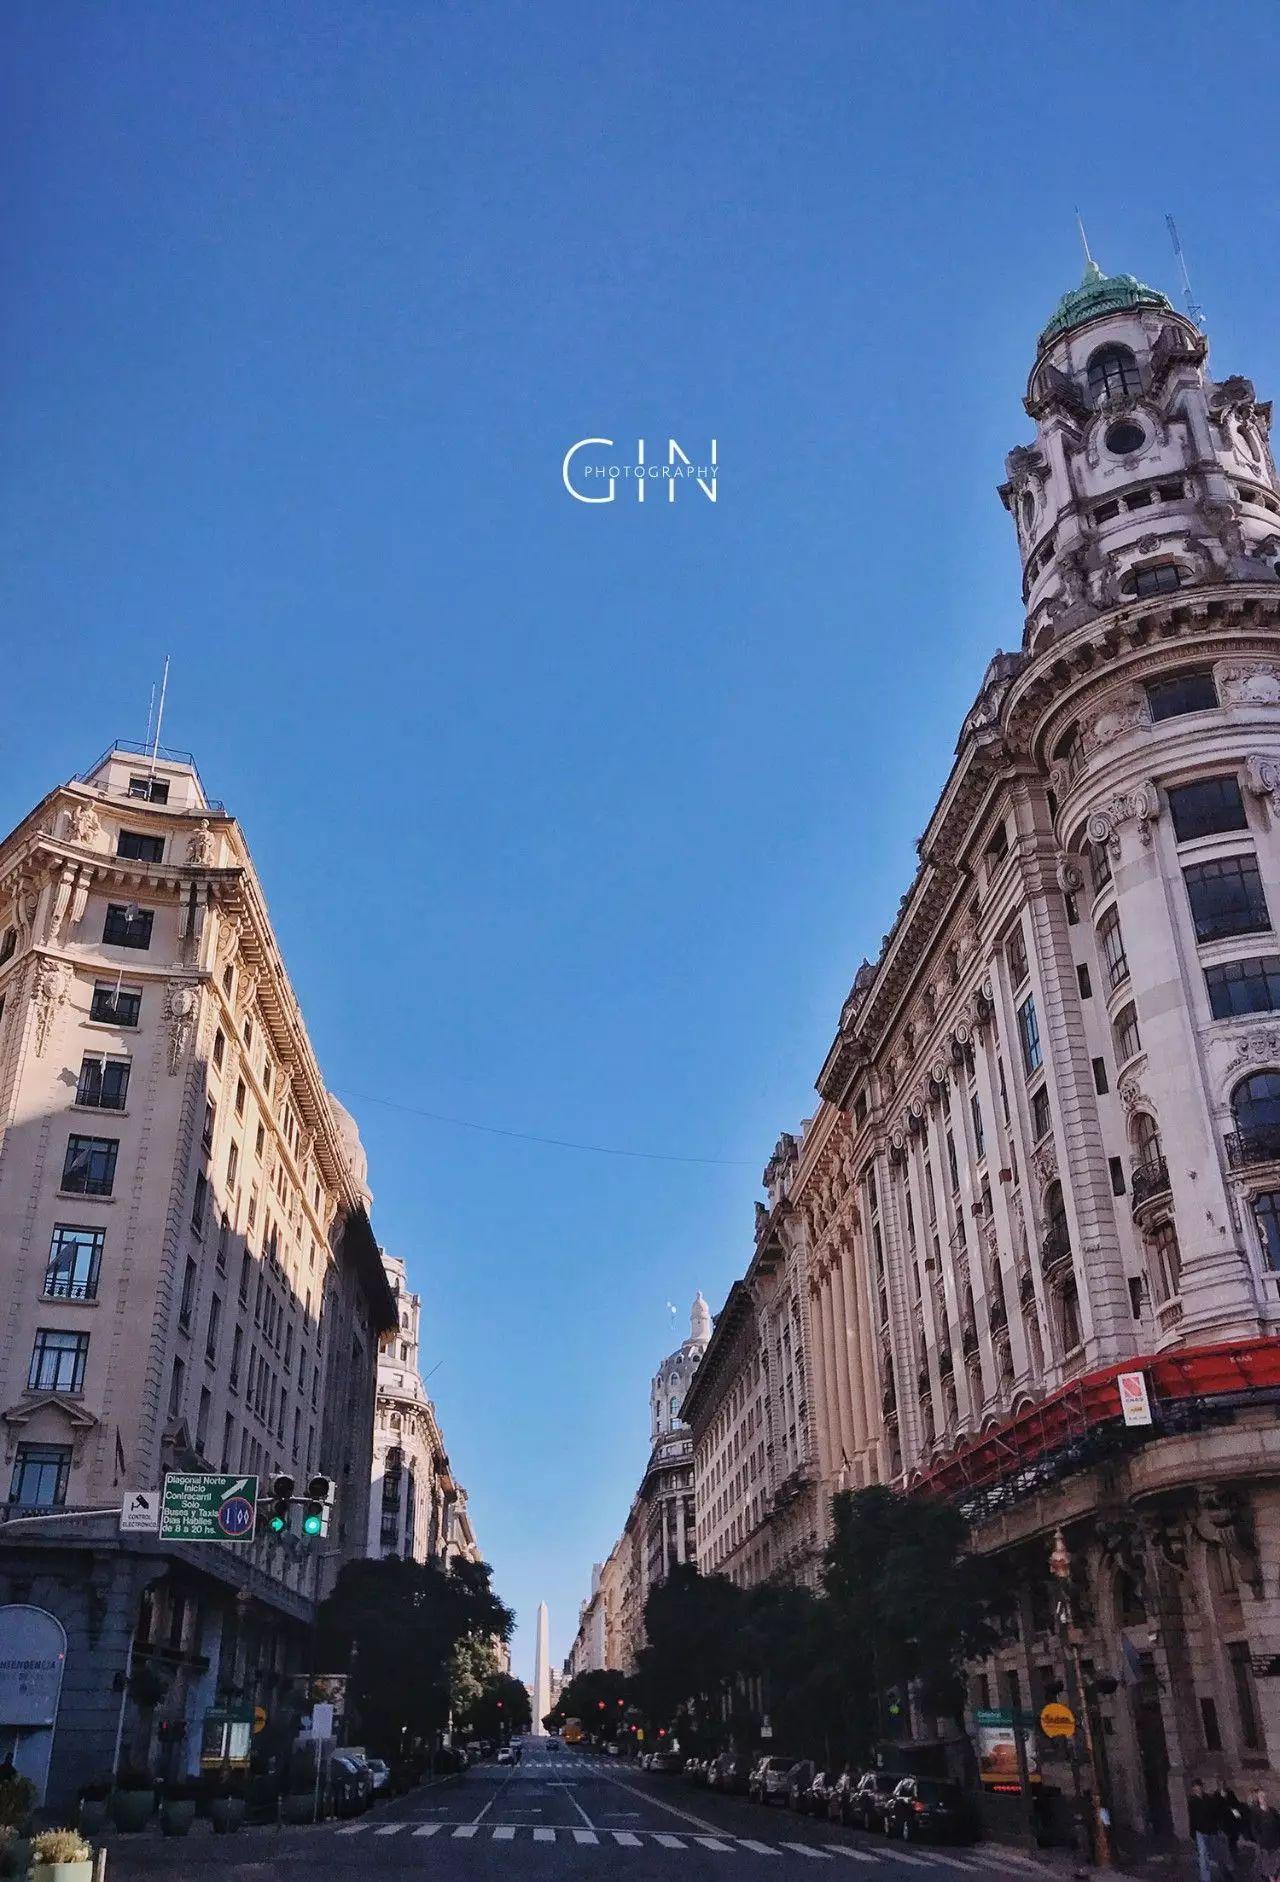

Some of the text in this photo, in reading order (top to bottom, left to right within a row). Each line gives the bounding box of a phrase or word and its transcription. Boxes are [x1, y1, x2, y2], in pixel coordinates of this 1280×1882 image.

[167, 1475, 227, 1486] Diagonal Norte
[184, 1483, 206, 1493] Inicio
[181, 1500, 200, 1508] Solo
[163, 1507, 189, 1516] Buses
[191, 1510, 196, 1518] y
[162, 1524, 173, 1533] de
[175, 1525, 181, 1533] 8
[191, 1525, 203, 1534] 20
